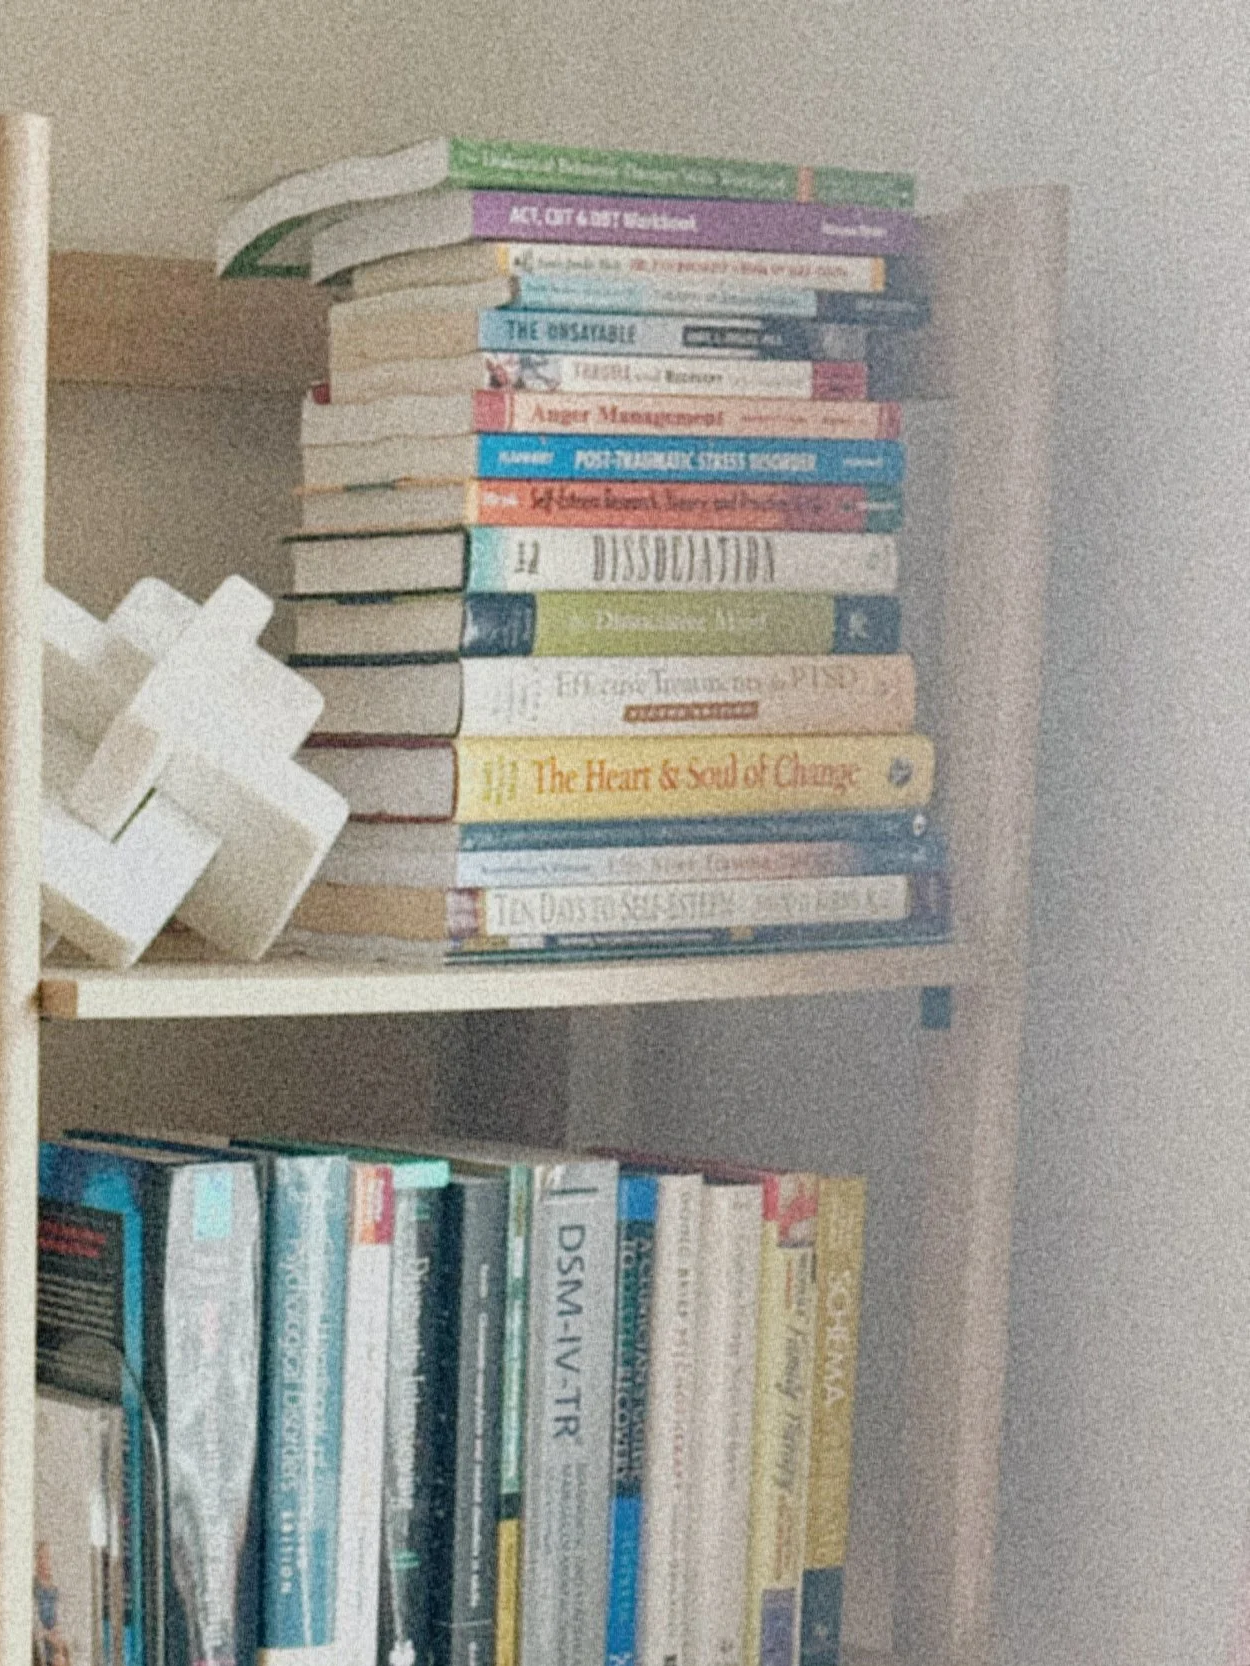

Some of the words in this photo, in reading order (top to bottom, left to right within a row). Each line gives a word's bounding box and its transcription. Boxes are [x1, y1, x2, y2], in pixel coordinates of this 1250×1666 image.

[507, 319, 538, 342] THE
[546, 321, 638, 346] UNSAYABLE
[529, 405, 591, 427] Anger
[597, 404, 726, 428] Management
[592, 534, 776, 583] DISSOCIATION
[532, 754, 578, 796] The
[583, 757, 653, 794] Heart
[657, 756, 680, 791] &
[687, 750, 738, 791] Soul
[743, 750, 769, 787] of
[774, 750, 861, 795] Change
[552, 1223, 588, 1442] DSM-IV-TR
[824, 1268, 852, 1408] SCHEMA
